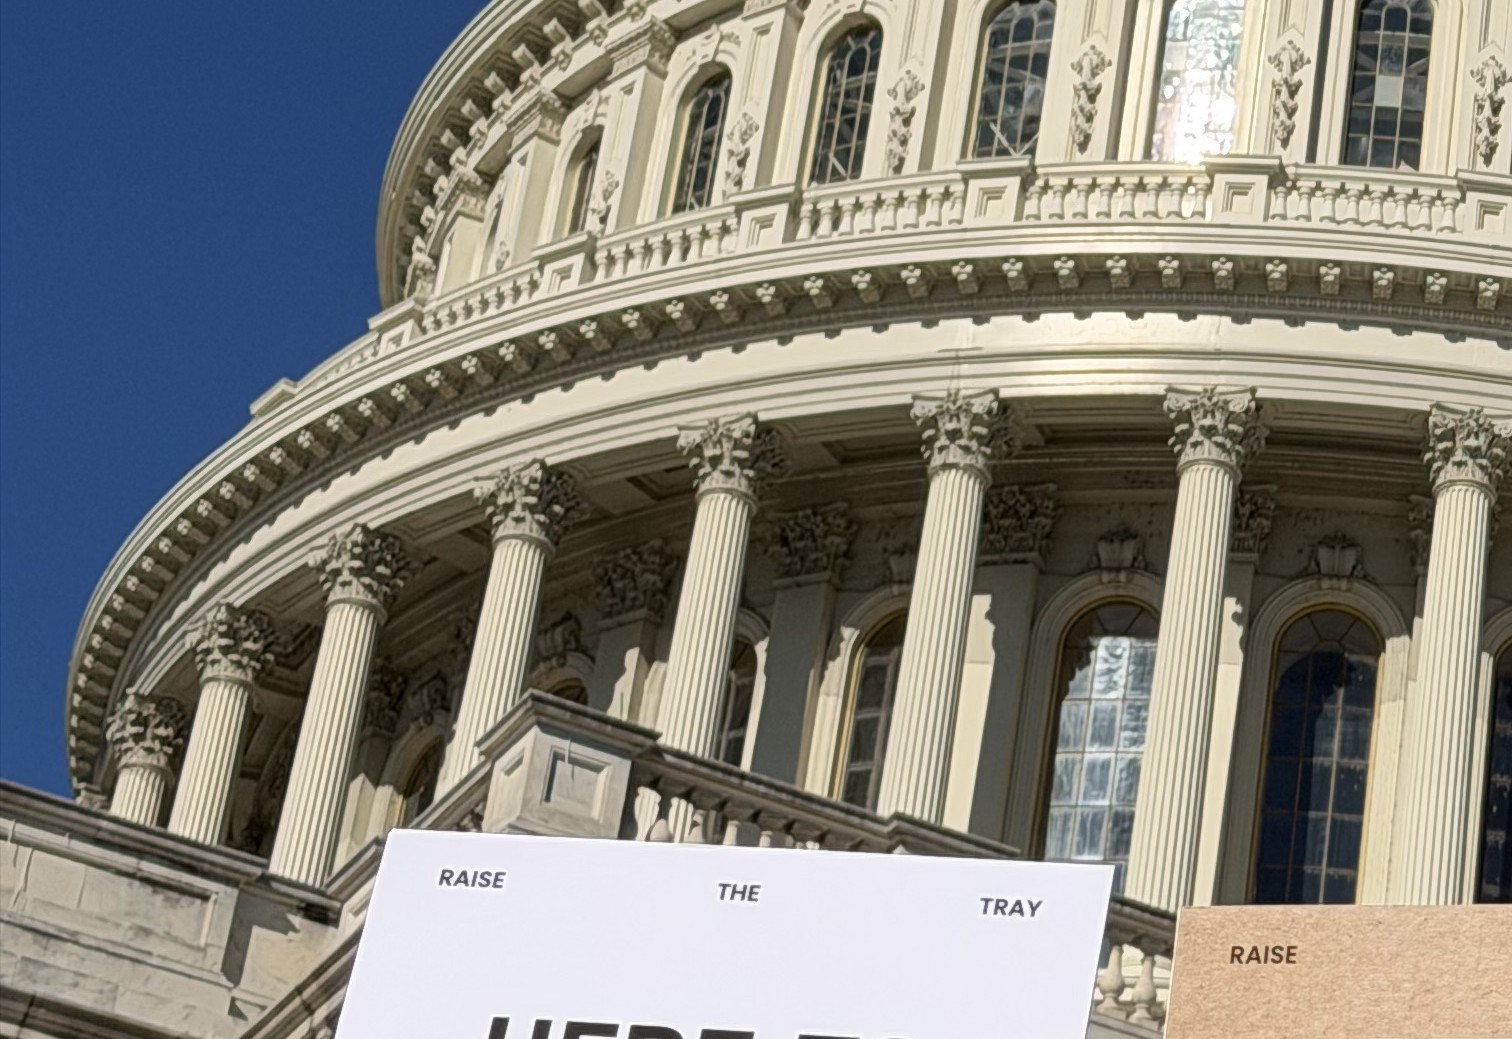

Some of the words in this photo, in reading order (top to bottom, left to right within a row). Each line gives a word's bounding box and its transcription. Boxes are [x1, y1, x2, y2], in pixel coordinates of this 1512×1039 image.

[438, 868, 507, 889] RAISE
[718, 882, 761, 902] THE
[980, 897, 1043, 918] TRAY
[1229, 945, 1298, 965] RAISE
